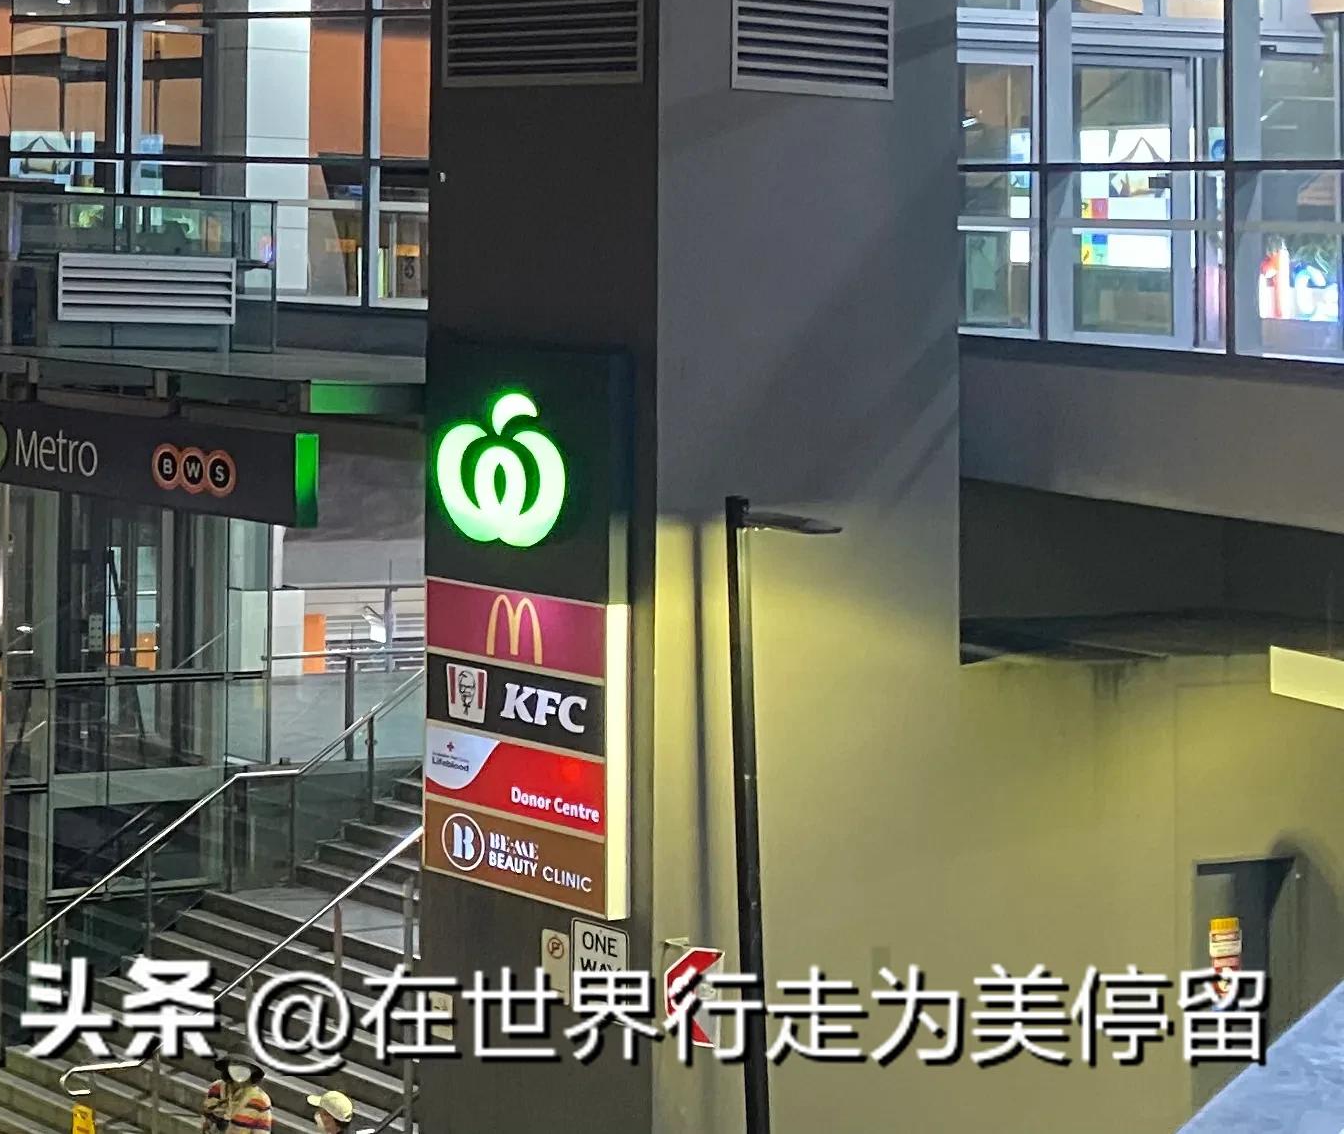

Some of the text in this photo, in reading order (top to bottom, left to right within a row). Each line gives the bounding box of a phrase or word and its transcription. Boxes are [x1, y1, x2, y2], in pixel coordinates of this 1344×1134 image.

[15, 428, 98, 477] Metro
[500, 682, 588, 734] KFC
[510, 786, 600, 823] Donor Centre
[488, 850, 593, 893] BEAUTY CLINIC
[582, 931, 618, 958] ONE
